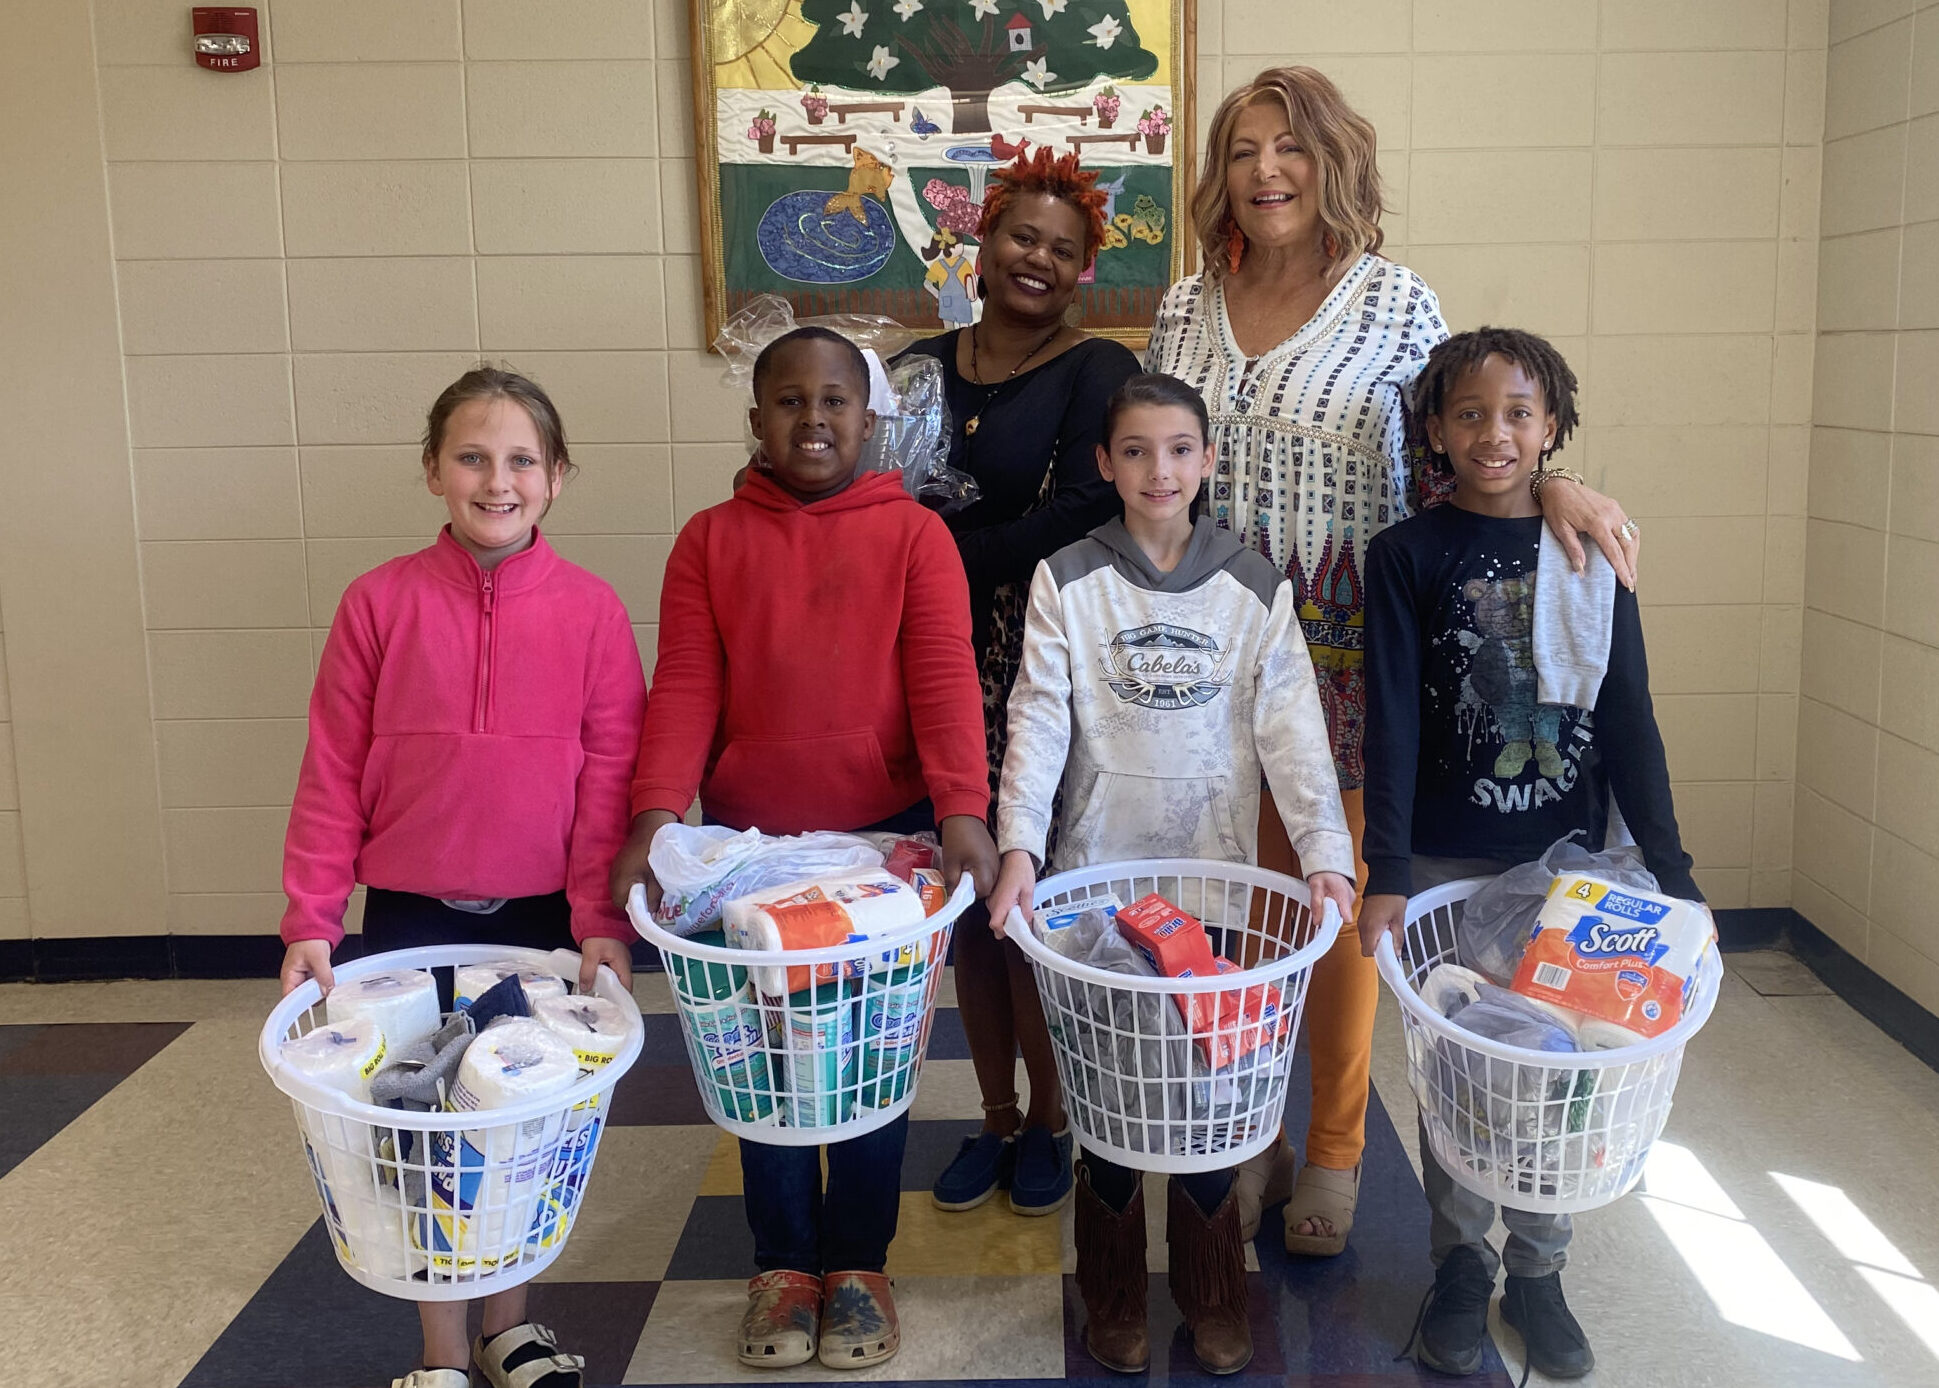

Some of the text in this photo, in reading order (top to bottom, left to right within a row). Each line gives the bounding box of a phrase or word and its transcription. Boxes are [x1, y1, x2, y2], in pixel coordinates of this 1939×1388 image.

[210, 58, 238, 67] FIRE
[1119, 625, 1209, 646] BIG GAME HUNTER
[1127, 652, 1201, 674] Cabela's
[1154, 699, 1177, 708] 1961
[1577, 883, 1592, 898] 4
[1604, 901, 1642, 918] ROLLS
[1607, 893, 1663, 916] REGULAR
[1159, 916, 1186, 938] Brillo
[1579, 922, 1658, 954] Scott
[1576, 958, 1645, 970] Comfort Plus
[585, 1054, 599, 1063] BIG
[364, 1062, 375, 1075] BIG
